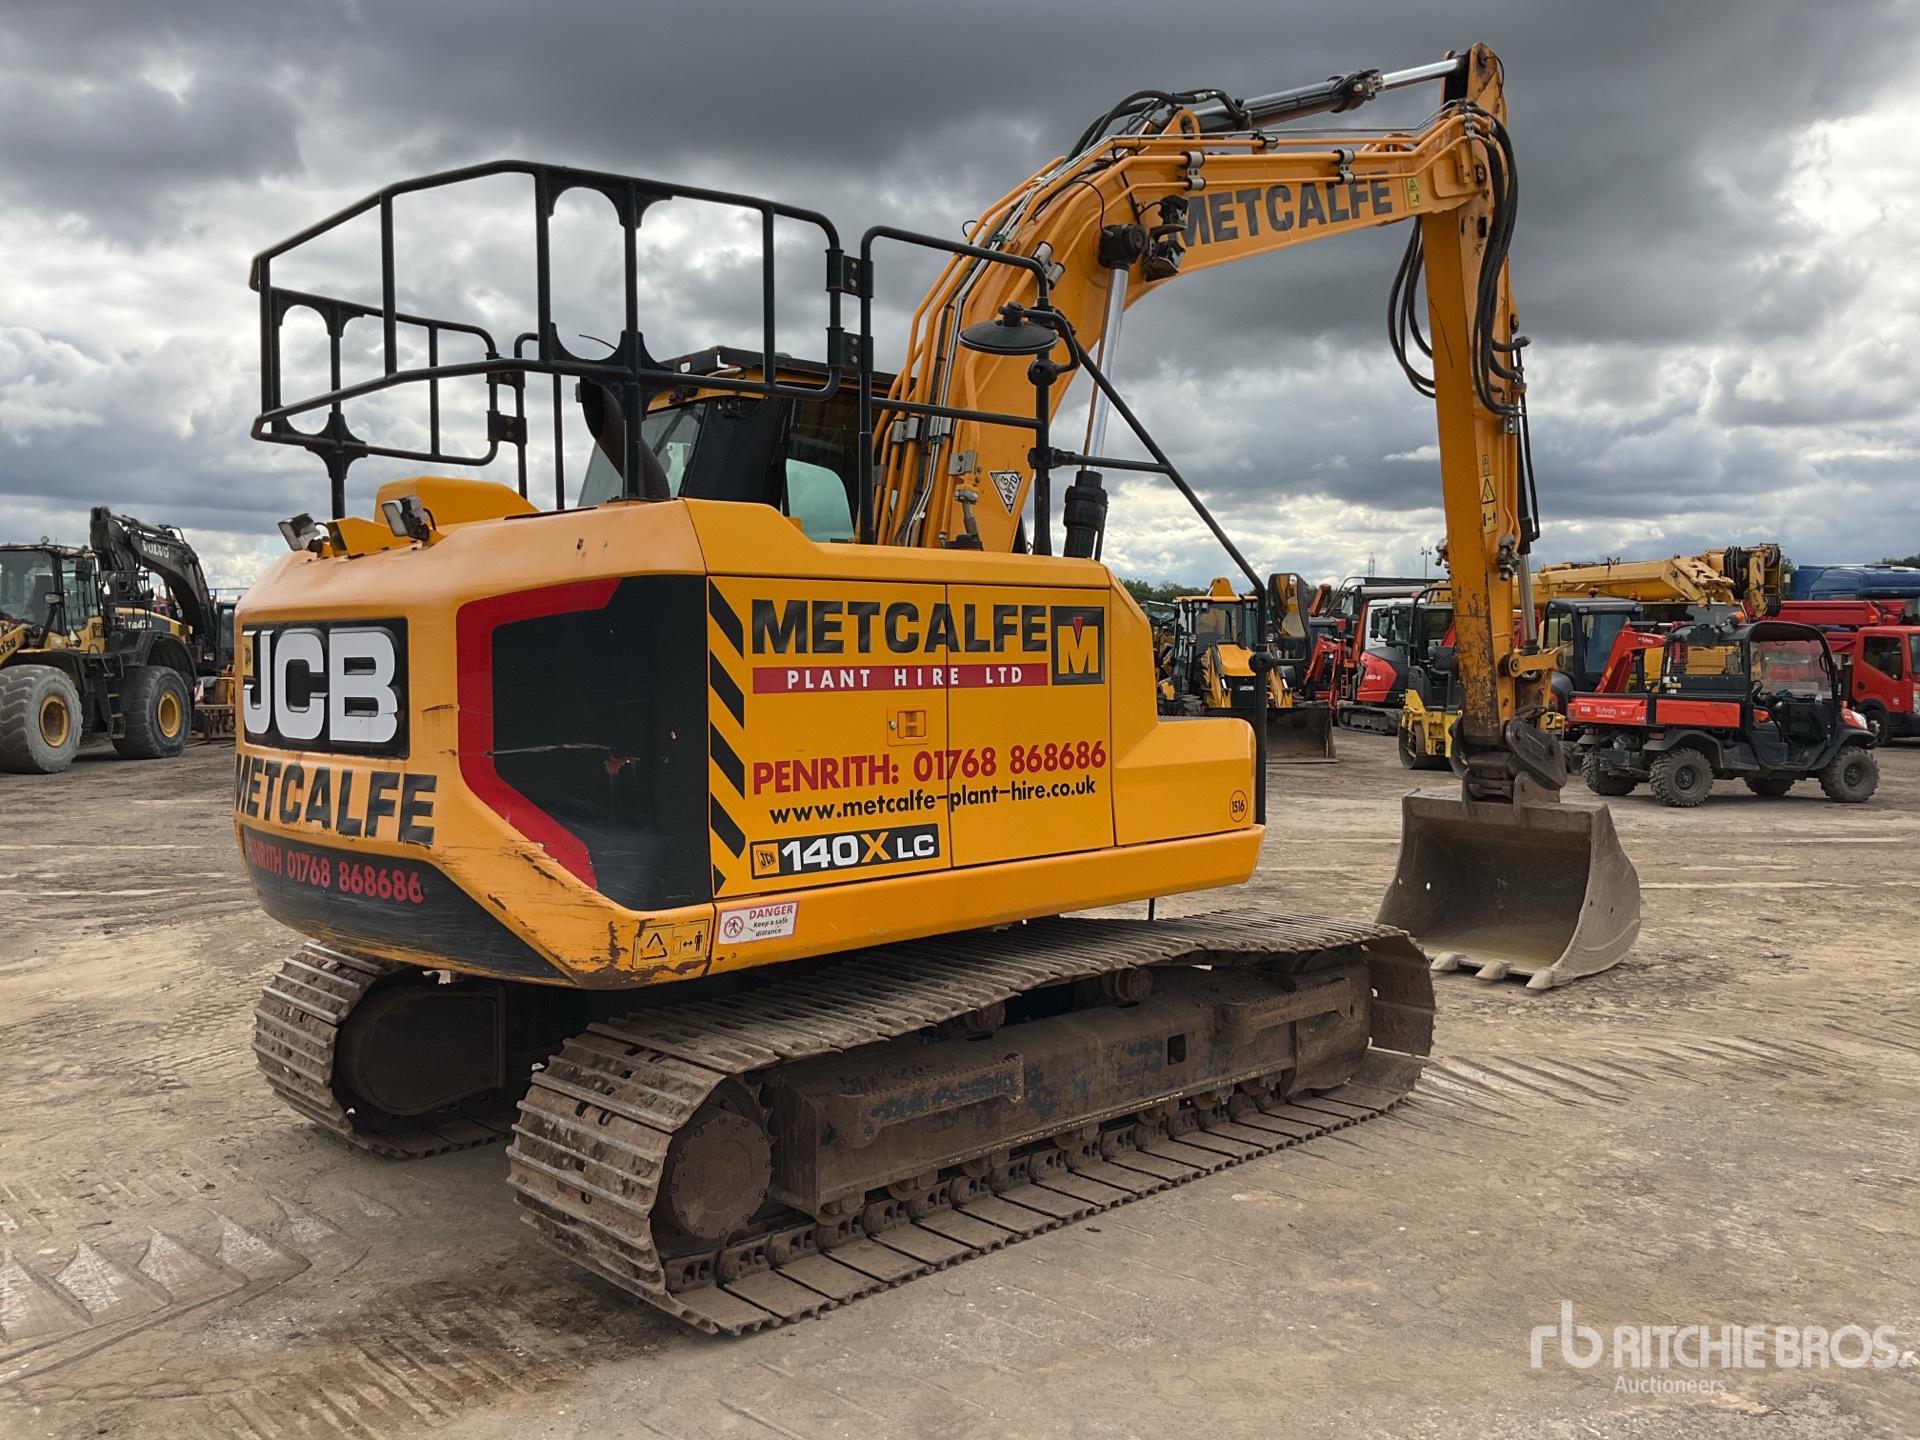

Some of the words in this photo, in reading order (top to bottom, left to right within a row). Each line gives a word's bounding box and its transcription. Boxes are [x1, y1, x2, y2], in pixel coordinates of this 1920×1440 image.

[1167, 170, 1393, 247] METCALFE
[142, 540, 170, 559] VOLVO
[752, 598, 1048, 655] METCALFE
[242, 627, 401, 743] JCB
[787, 669, 871, 690] PLANT
[894, 667, 959, 687] HIRE
[985, 666, 1023, 685] LTD
[753, 754, 899, 795] PENRITH:
[913, 746, 997, 781] 01768
[1009, 740, 1107, 775] 868686
[235, 752, 437, 846] METCALFE
[769, 774, 1097, 825] www.metcalfe-plant-hire.co.uk
[760, 852, 775, 867] JCB
[781, 831, 892, 872] 140X
[896, 834, 936, 859] LC
[286, 849, 331, 889] 01768
[338, 860, 425, 904] 868686
[749, 904, 794, 920] DANGER
[753, 920, 769, 929] Keep
[775, 916, 789, 926] safe
[755, 928, 782, 937] distance
